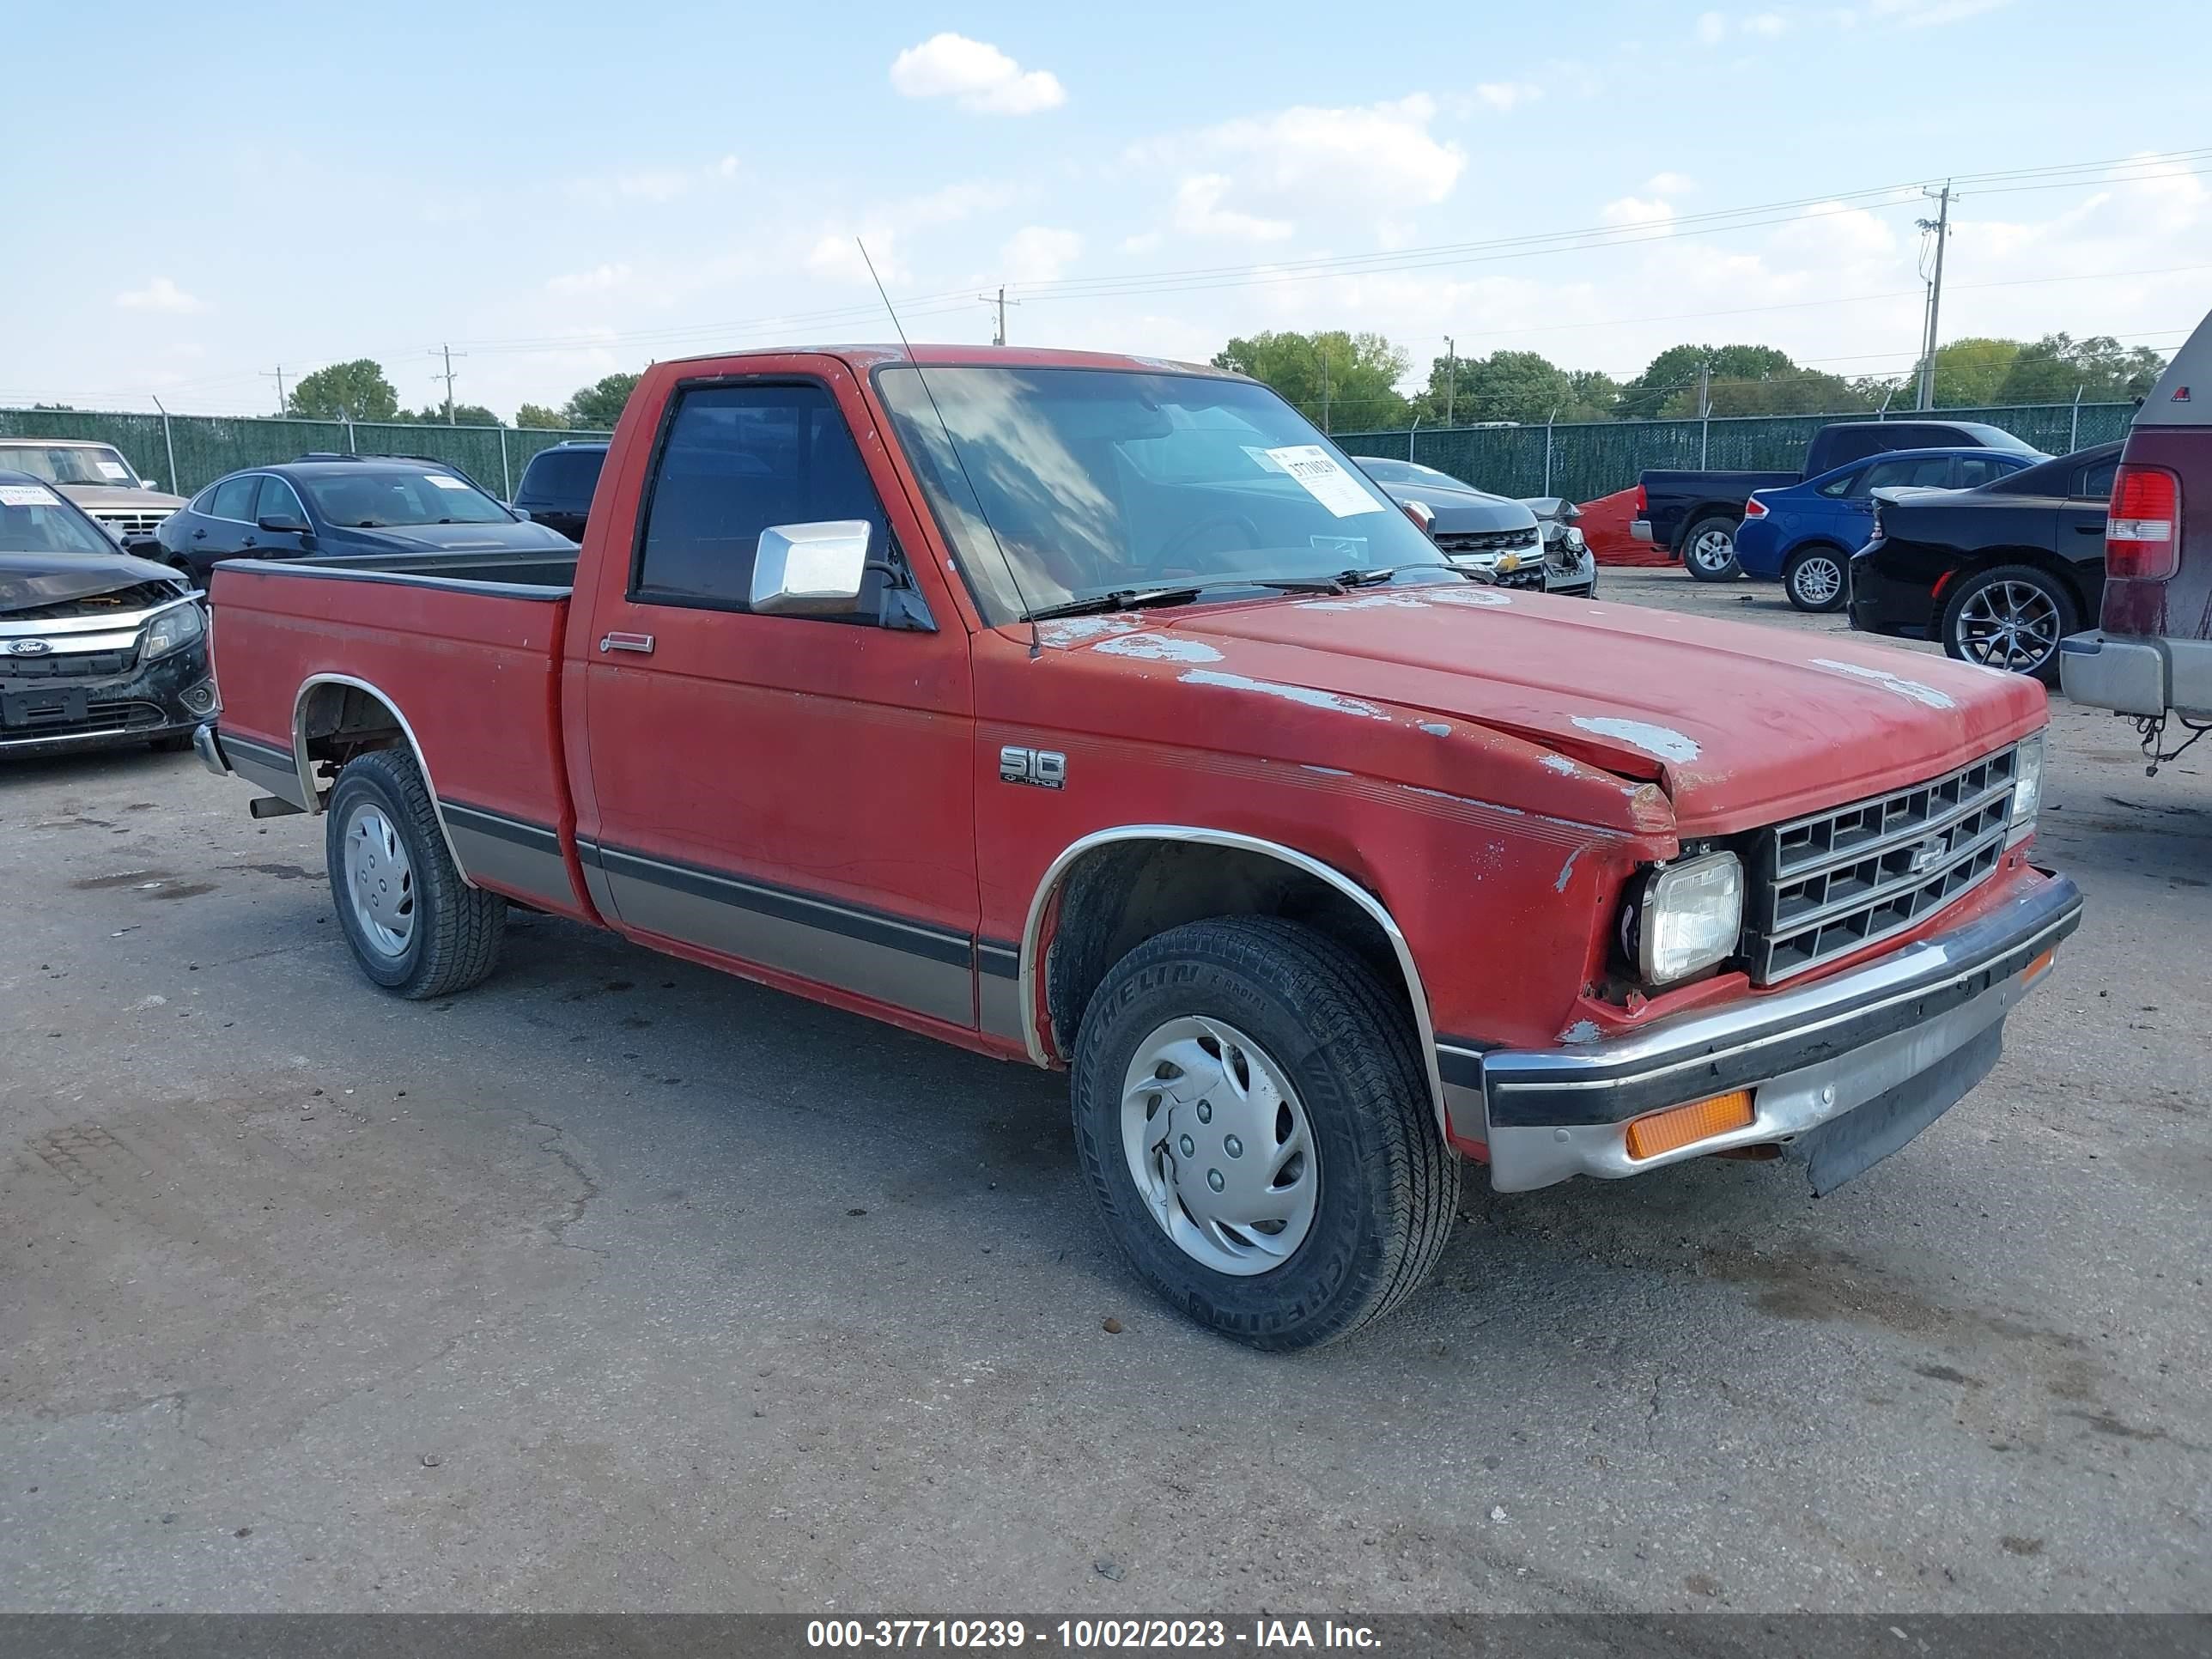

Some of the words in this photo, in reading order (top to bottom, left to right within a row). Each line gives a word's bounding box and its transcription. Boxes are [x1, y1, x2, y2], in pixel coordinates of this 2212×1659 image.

[17, 641, 43, 653] Ford
[1000, 745, 1065, 781] S10
[1024, 776, 1059, 787] TAHOE
[1079, 963, 1200, 1115] MICHELIN
